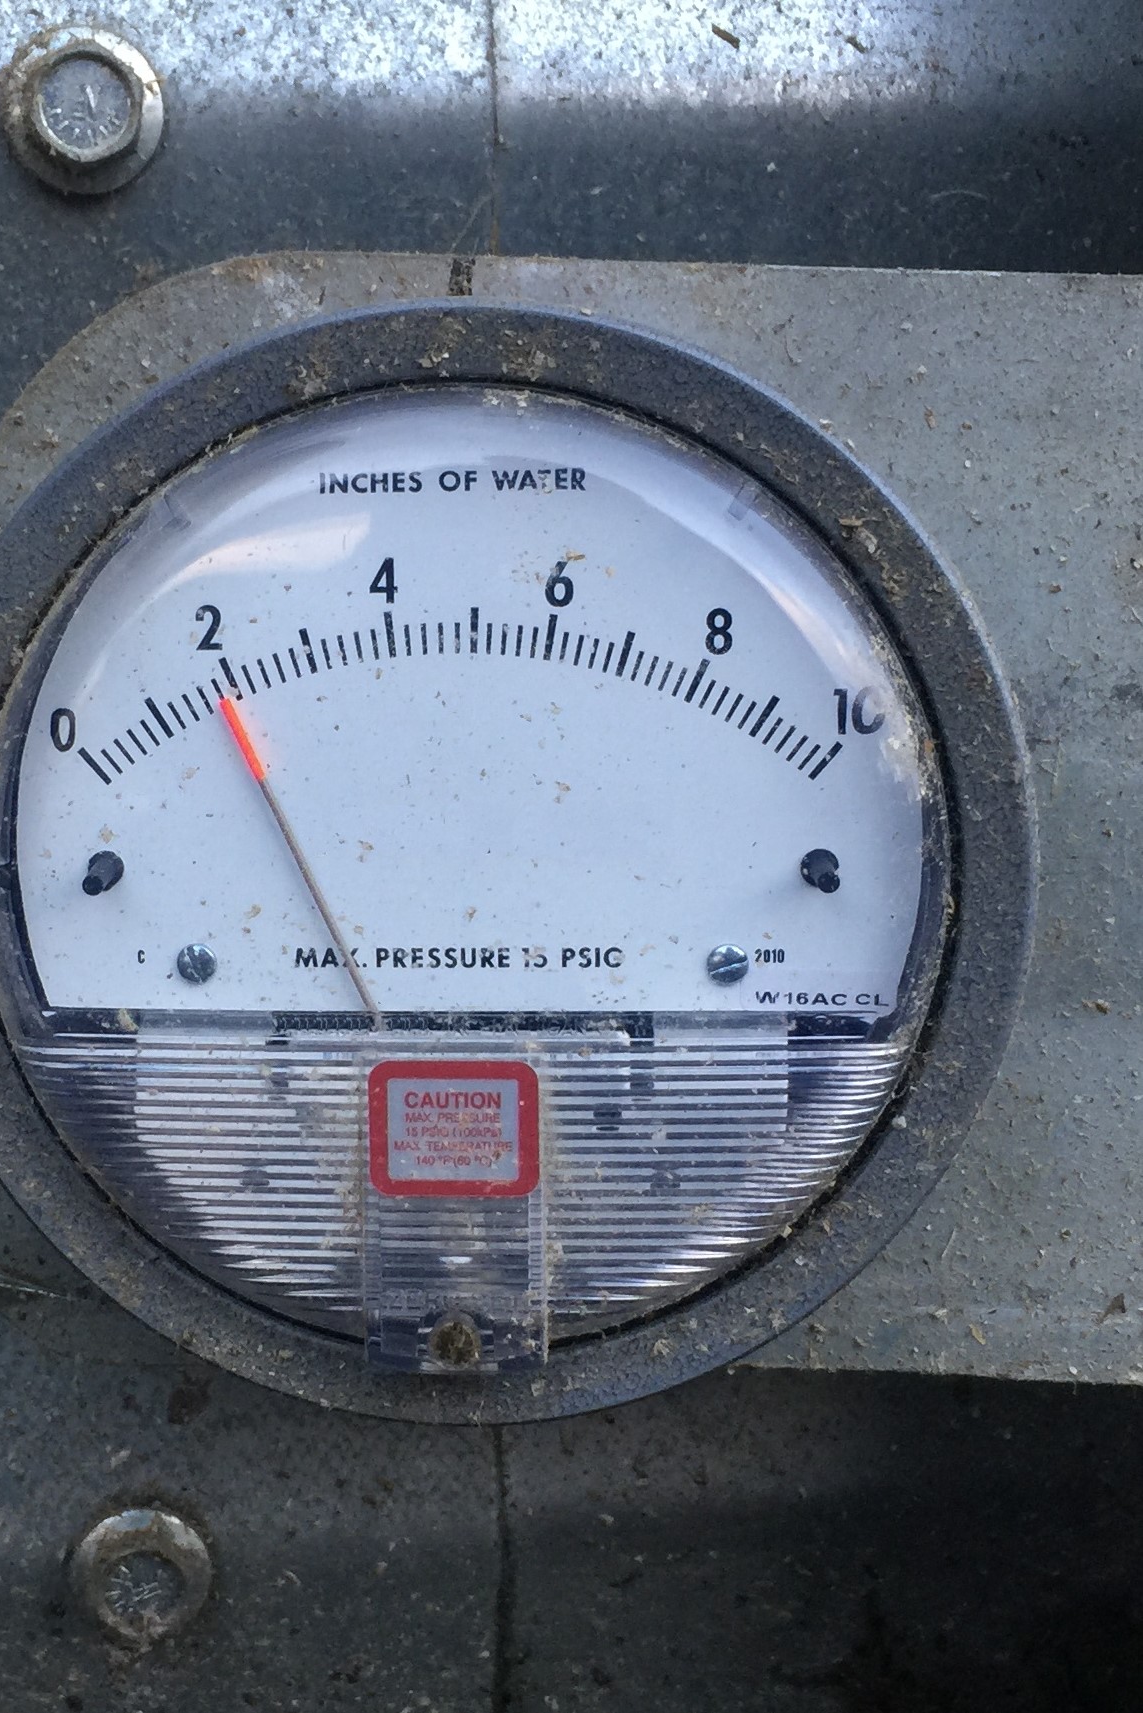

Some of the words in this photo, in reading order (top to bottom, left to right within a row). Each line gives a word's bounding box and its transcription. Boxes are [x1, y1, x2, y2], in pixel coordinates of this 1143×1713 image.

[319, 472, 423, 494] INCHES
[438, 470, 477, 492] OF
[491, 468, 586, 492] WATER
[369, 556, 398, 604] 4
[545, 560, 574, 607] 6
[195, 604, 223, 651] 2
[705, 608, 733, 655] 8
[833, 686, 886, 735] 10
[50, 708, 76, 752] 0
[137, 949, 146, 964] C
[294, 947, 367, 968] MAX.
[375, 947, 510, 968] PRESSURE
[522, 947, 548, 968] 15
[754, 948, 785, 964] 2010
[855, 993, 889, 1007] CL
[404, 1091, 502, 1109] CAUTION
[406, 1126, 418, 1137] 15
[416, 1155, 435, 1166] 140
